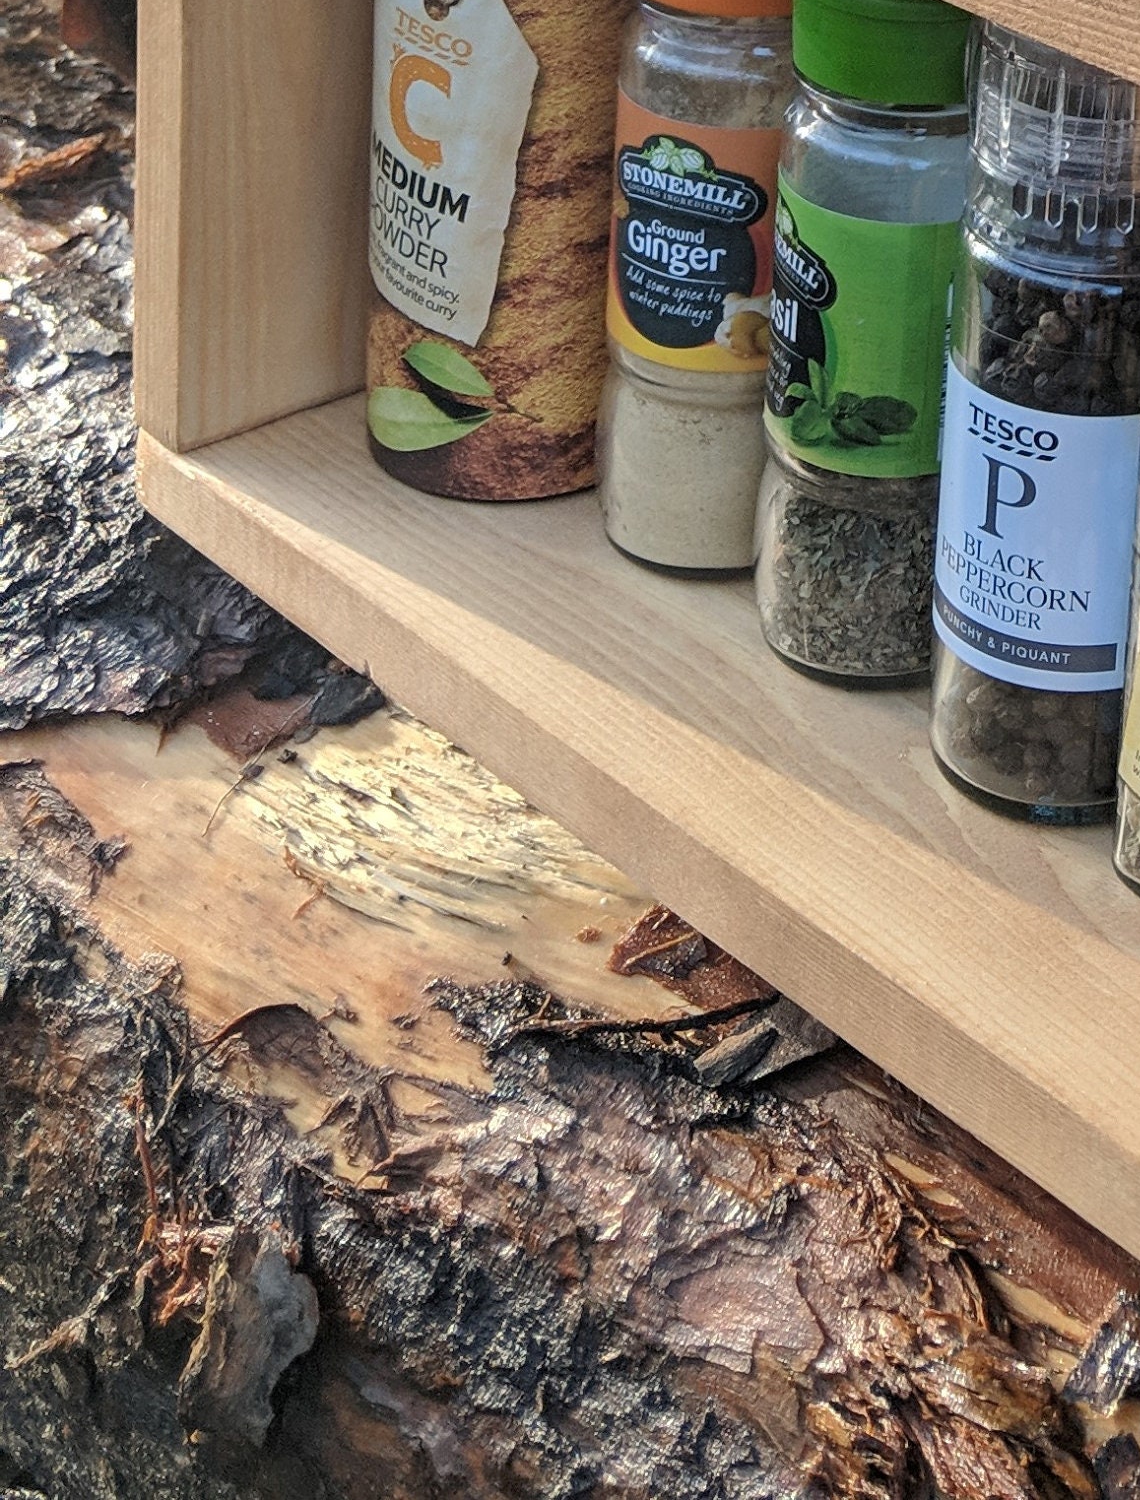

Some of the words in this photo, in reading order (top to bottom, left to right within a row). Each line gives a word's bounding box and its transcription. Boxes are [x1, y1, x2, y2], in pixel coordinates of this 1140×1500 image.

[395, 6, 474, 59] TESCO
[388, 52, 452, 170] C
[375, 174, 442, 240] CURRY
[622, 160, 748, 211] STONEMILL
[662, 191, 735, 217] INGREDIENTS
[371, 203, 449, 279] OWDER
[627, 219, 728, 278] Ginger
[651, 218, 706, 245] Ground
[405, 267, 427, 290] and
[625, 264, 644, 286] Add
[645, 278, 671, 296] some
[671, 285, 706, 304] spice
[707, 286, 723, 304] to
[424, 296, 458, 322] curry
[659, 302, 714, 329] puddings
[968, 400, 1060, 453] TESCO
[976, 452, 1038, 540] P
[939, 533, 1093, 613] PEPPERCORN
[962, 530, 1046, 583] BLACK
[942, 603, 983, 643] PUNCHY
[986, 636, 996, 649] &
[1001, 641, 1072, 665] PIQUANT
[958, 584, 1042, 631] GRINDER
